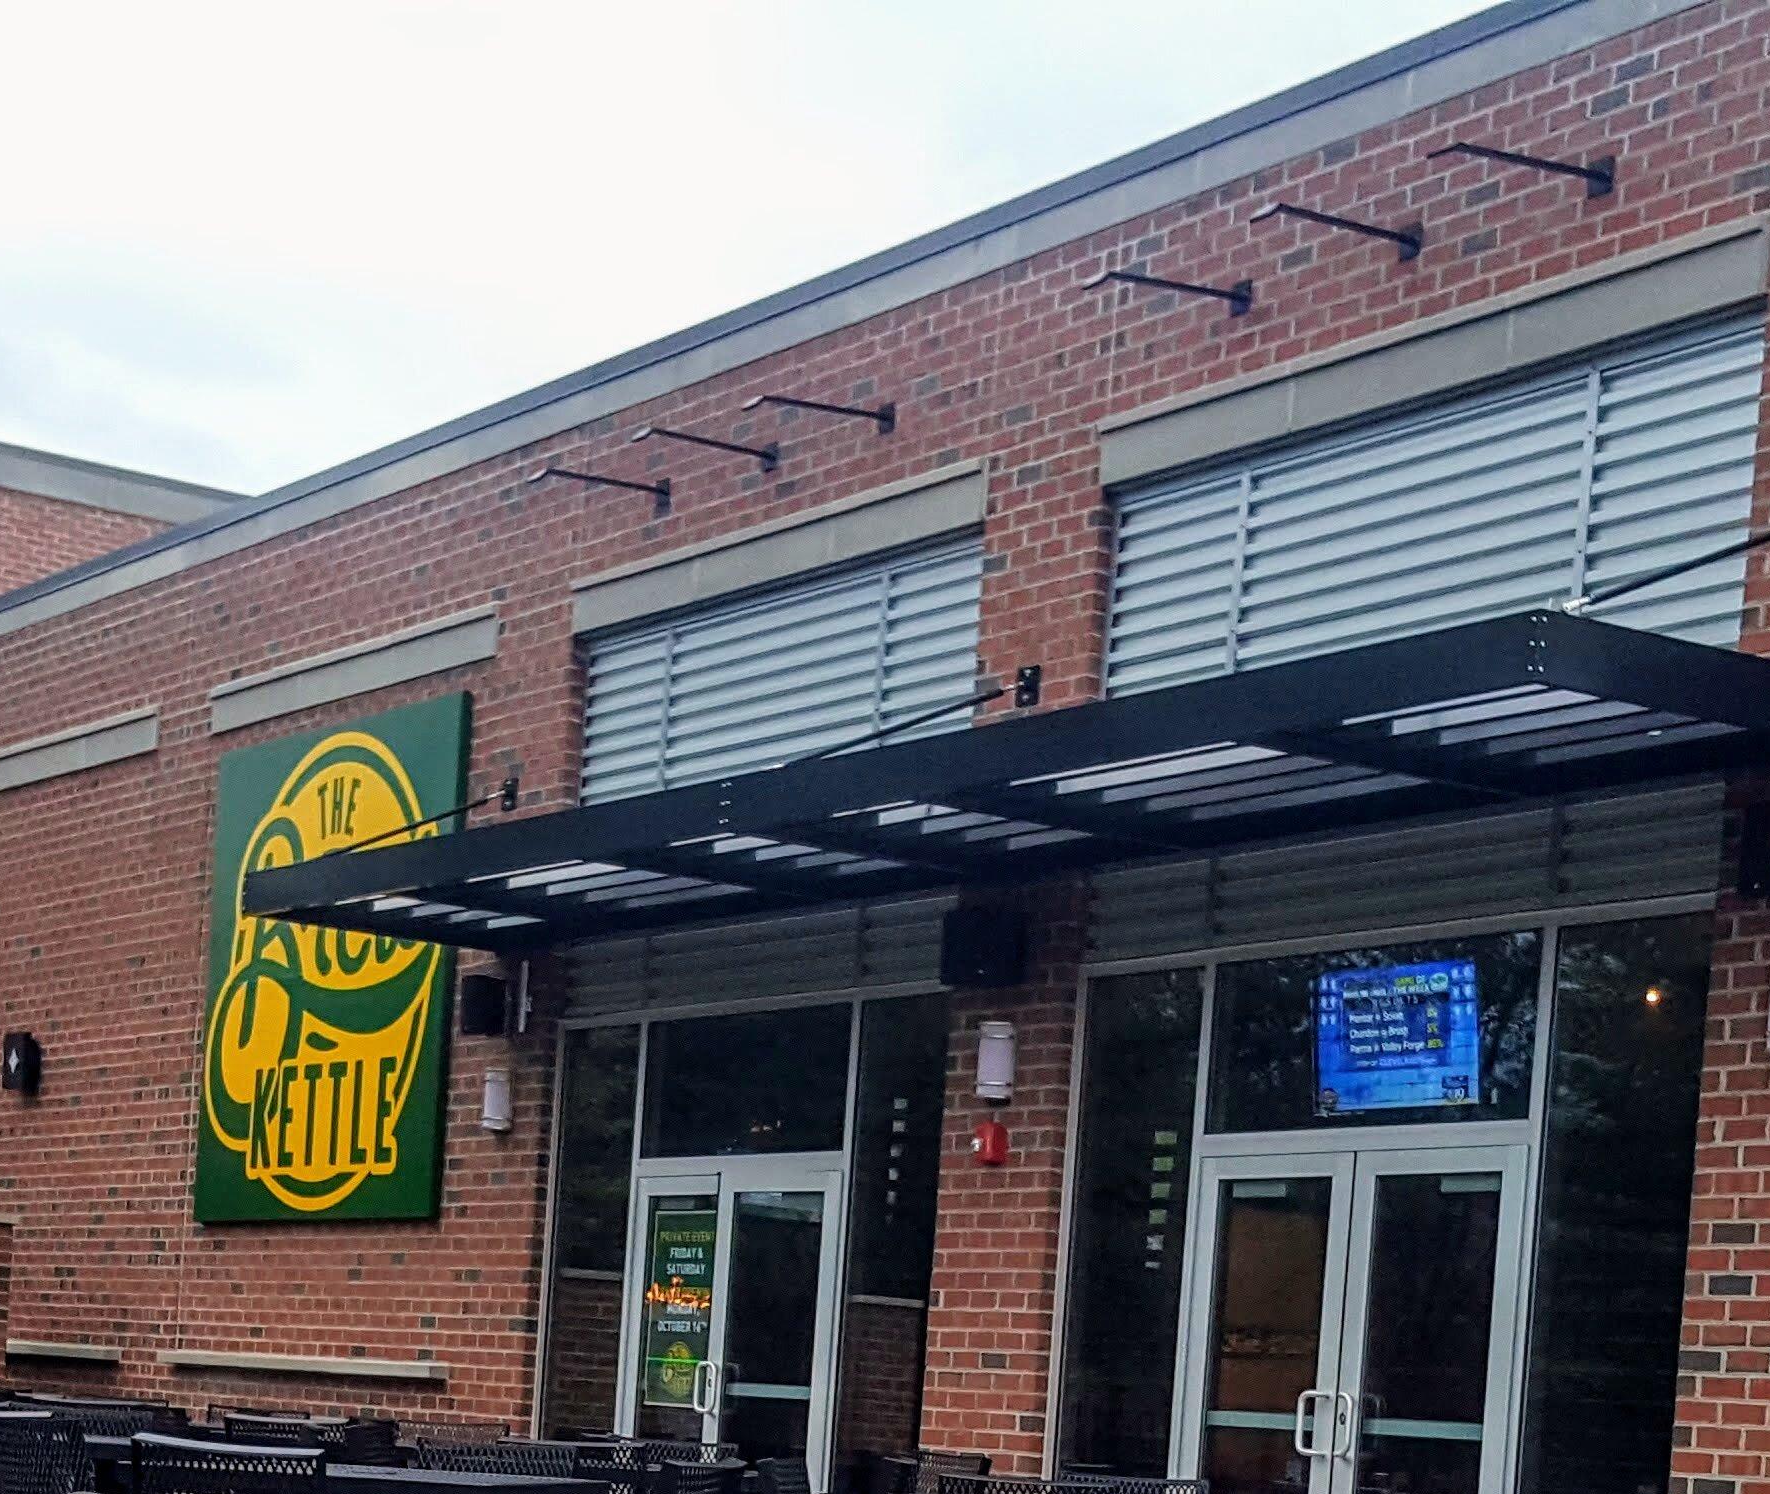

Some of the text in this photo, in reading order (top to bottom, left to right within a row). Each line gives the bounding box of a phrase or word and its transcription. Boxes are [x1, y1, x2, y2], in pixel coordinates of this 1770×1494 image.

[317, 776, 361, 841] THE
[250, 1056, 397, 1170] KETTLE
[666, 1263, 706, 1275] SATURDAY
